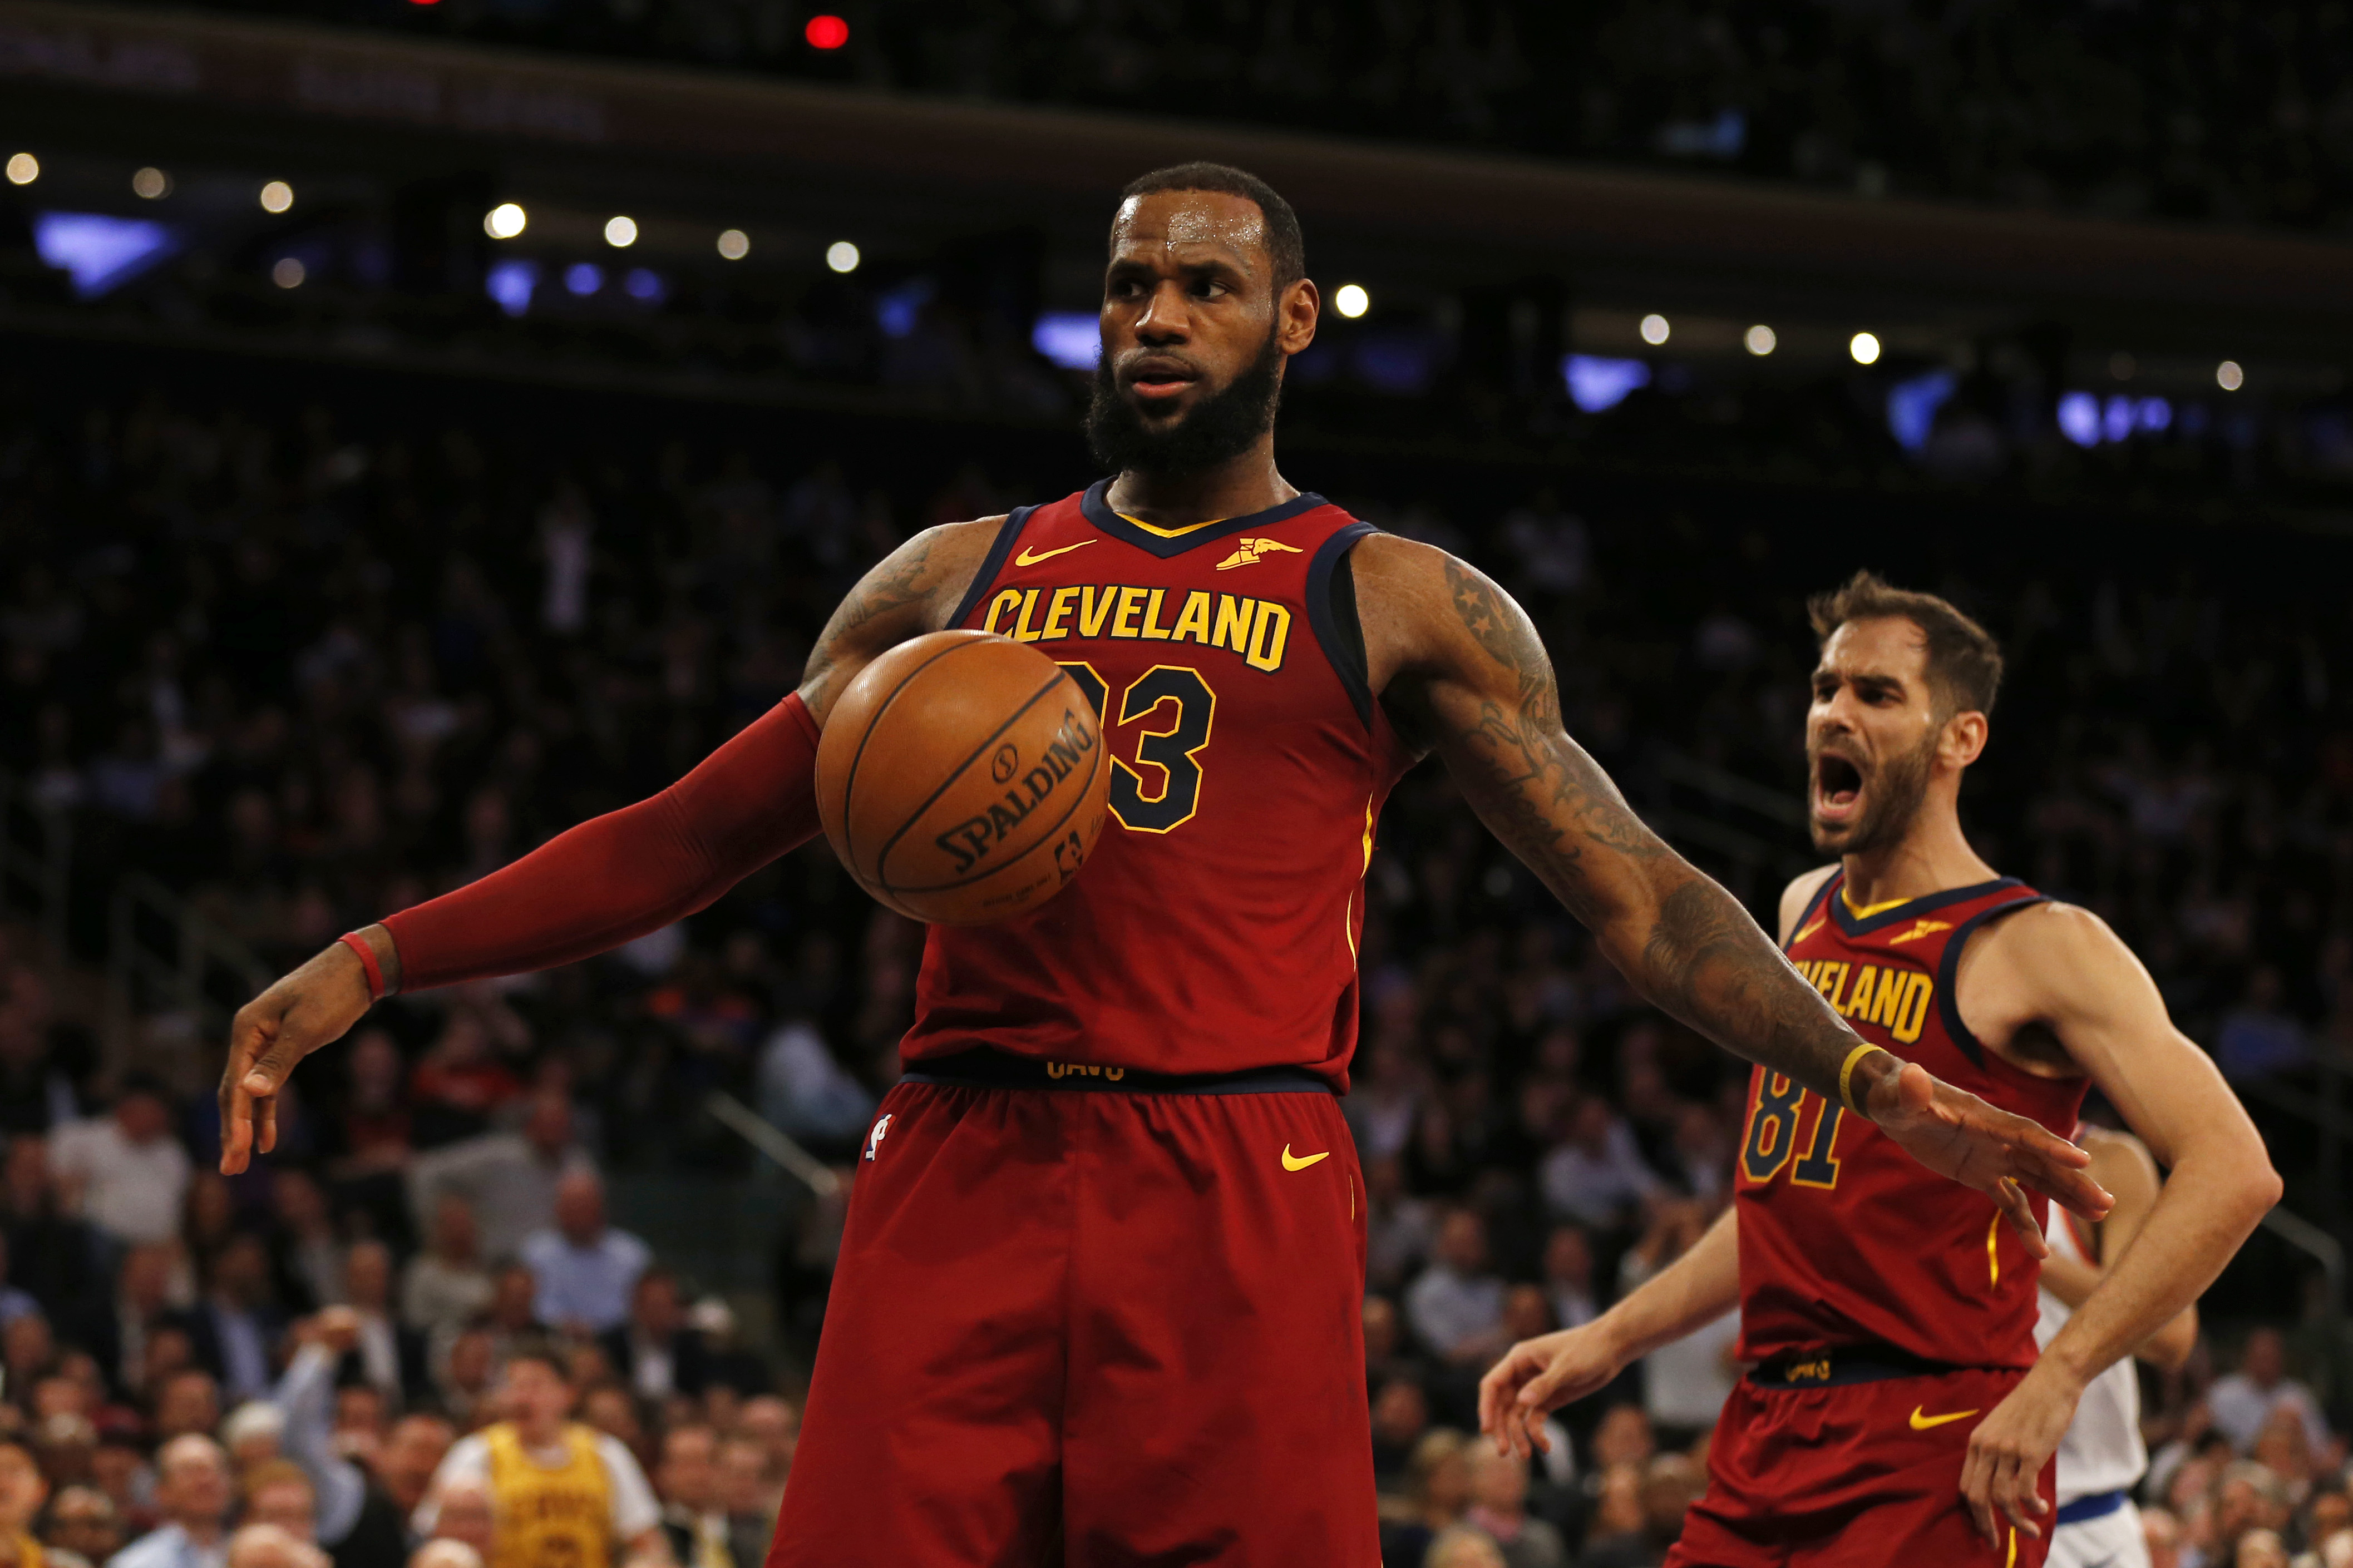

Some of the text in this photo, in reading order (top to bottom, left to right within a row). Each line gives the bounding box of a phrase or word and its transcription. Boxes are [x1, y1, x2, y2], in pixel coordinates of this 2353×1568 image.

[984, 584, 1292, 673] CLEVELAND
[935, 708, 1093, 873] SPALDING
[1740, 1065, 1846, 1190] 81
